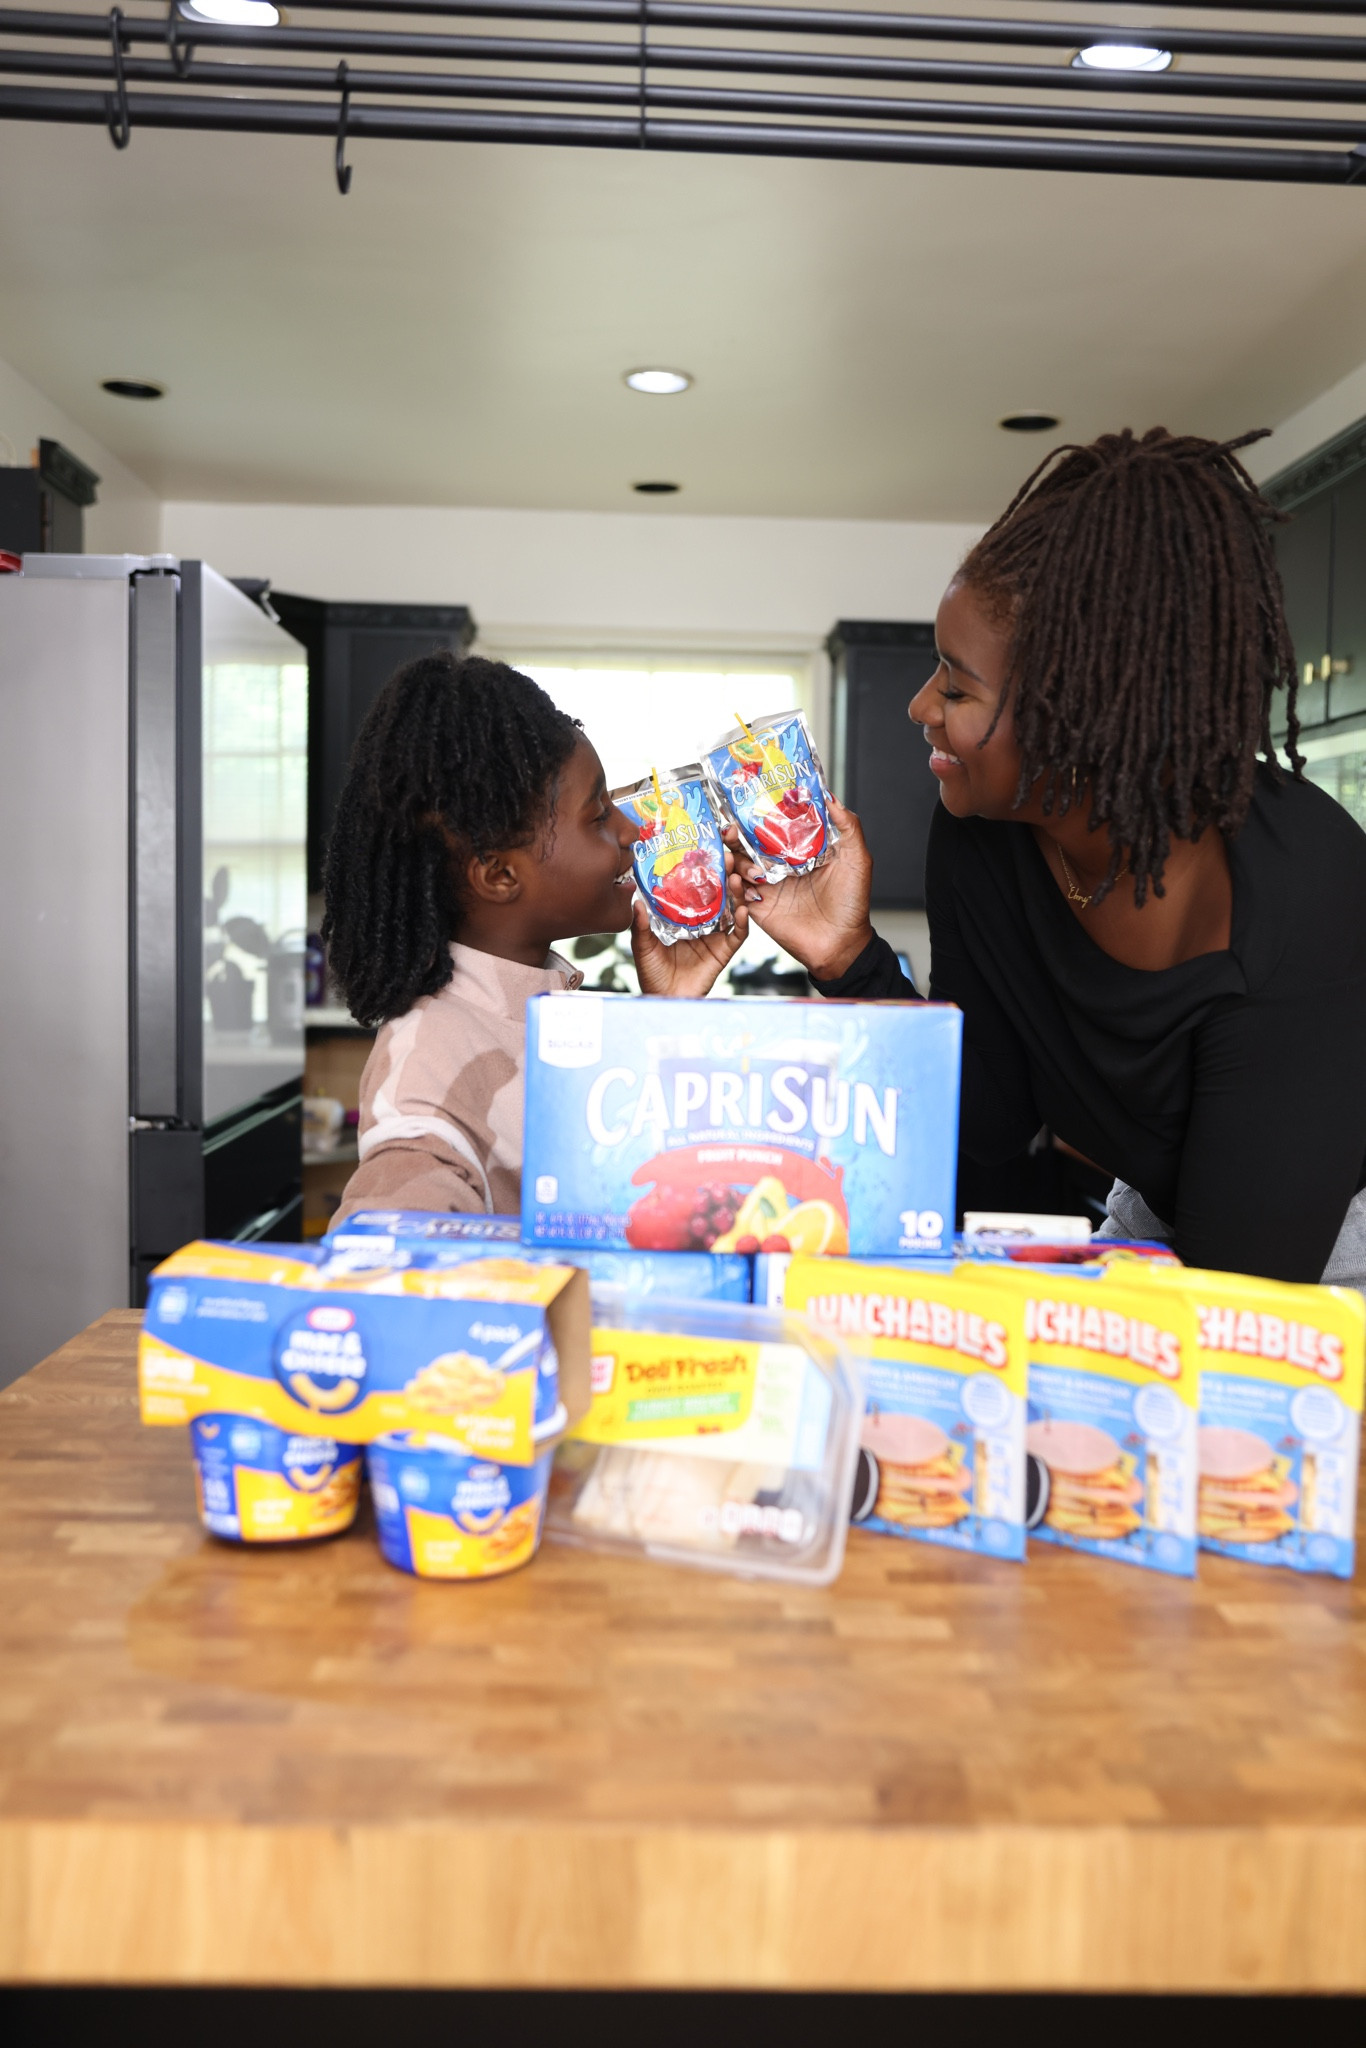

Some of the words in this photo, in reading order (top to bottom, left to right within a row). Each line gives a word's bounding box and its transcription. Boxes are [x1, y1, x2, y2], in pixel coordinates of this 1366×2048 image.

[731, 761, 812, 806] CAPRISUN
[633, 820, 715, 863] CAPRISUN
[586, 1066, 898, 1157] CAPRISUN
[697, 1150, 735, 1163] FRUIT
[736, 1149, 784, 1165] PUNCH
[900, 1210, 944, 1239] 10
